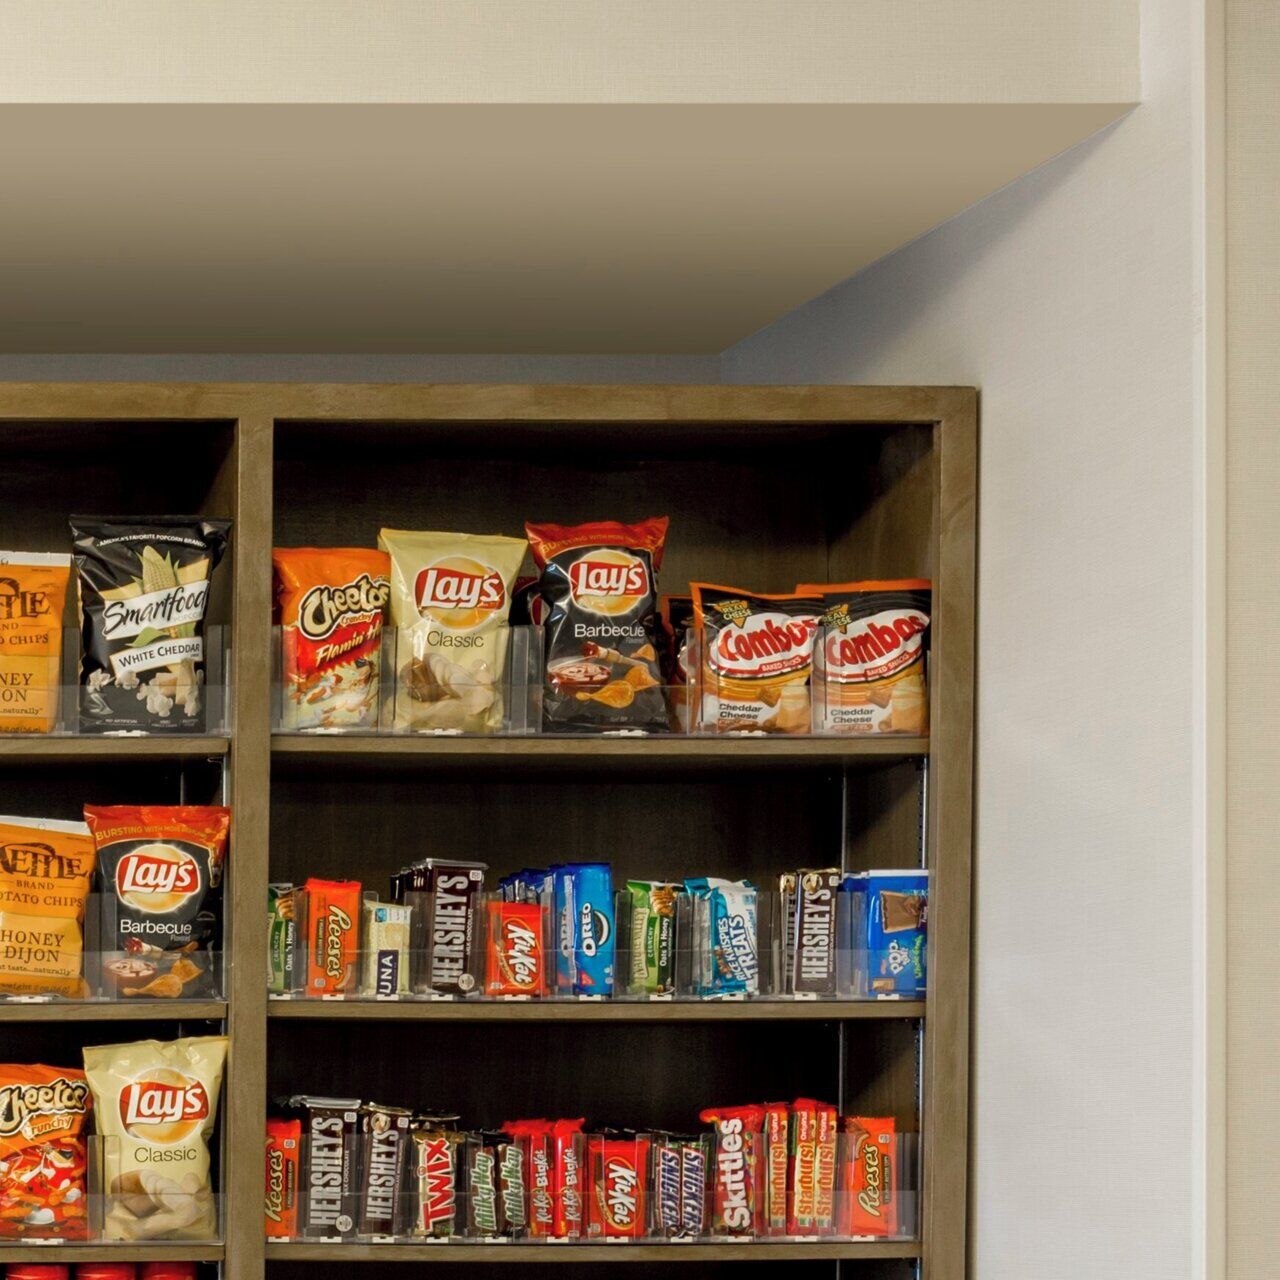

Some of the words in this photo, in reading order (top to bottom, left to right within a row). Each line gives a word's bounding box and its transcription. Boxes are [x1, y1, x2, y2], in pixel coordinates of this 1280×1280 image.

[422, 569, 500, 609] Lay's
[576, 563, 643, 596] Lay's
[103, 586, 207, 635] Smartfood
[427, 631, 484, 648] Classic
[575, 624, 644, 638] Barbecue
[719, 617, 817, 662] Combos
[828, 614, 926, 666] Combos
[118, 651, 154, 668] WHITE
[157, 643, 200, 658] CHEDDAR
[16, 880, 54, 890] BRAND
[125, 856, 194, 893] Lay's
[44, 895, 83, 907] CHIPS
[0, 930, 64, 946] HONEY
[120, 920, 192, 935] Barbecue
[327, 905, 351, 978] Reese's
[582, 903, 592, 956] OREO
[802, 889, 831, 978] HERSHEY'S
[4, 945, 59, 962] DIJON
[729, 915, 758, 981] TREATS
[127, 1085, 202, 1124] Lay's
[134, 1147, 197, 1163] Classic
[310, 1117, 343, 1224] HERSHEY'S
[366, 1130, 399, 1219] HERSHEY'S
[858, 1144, 880, 1216] Reese's
